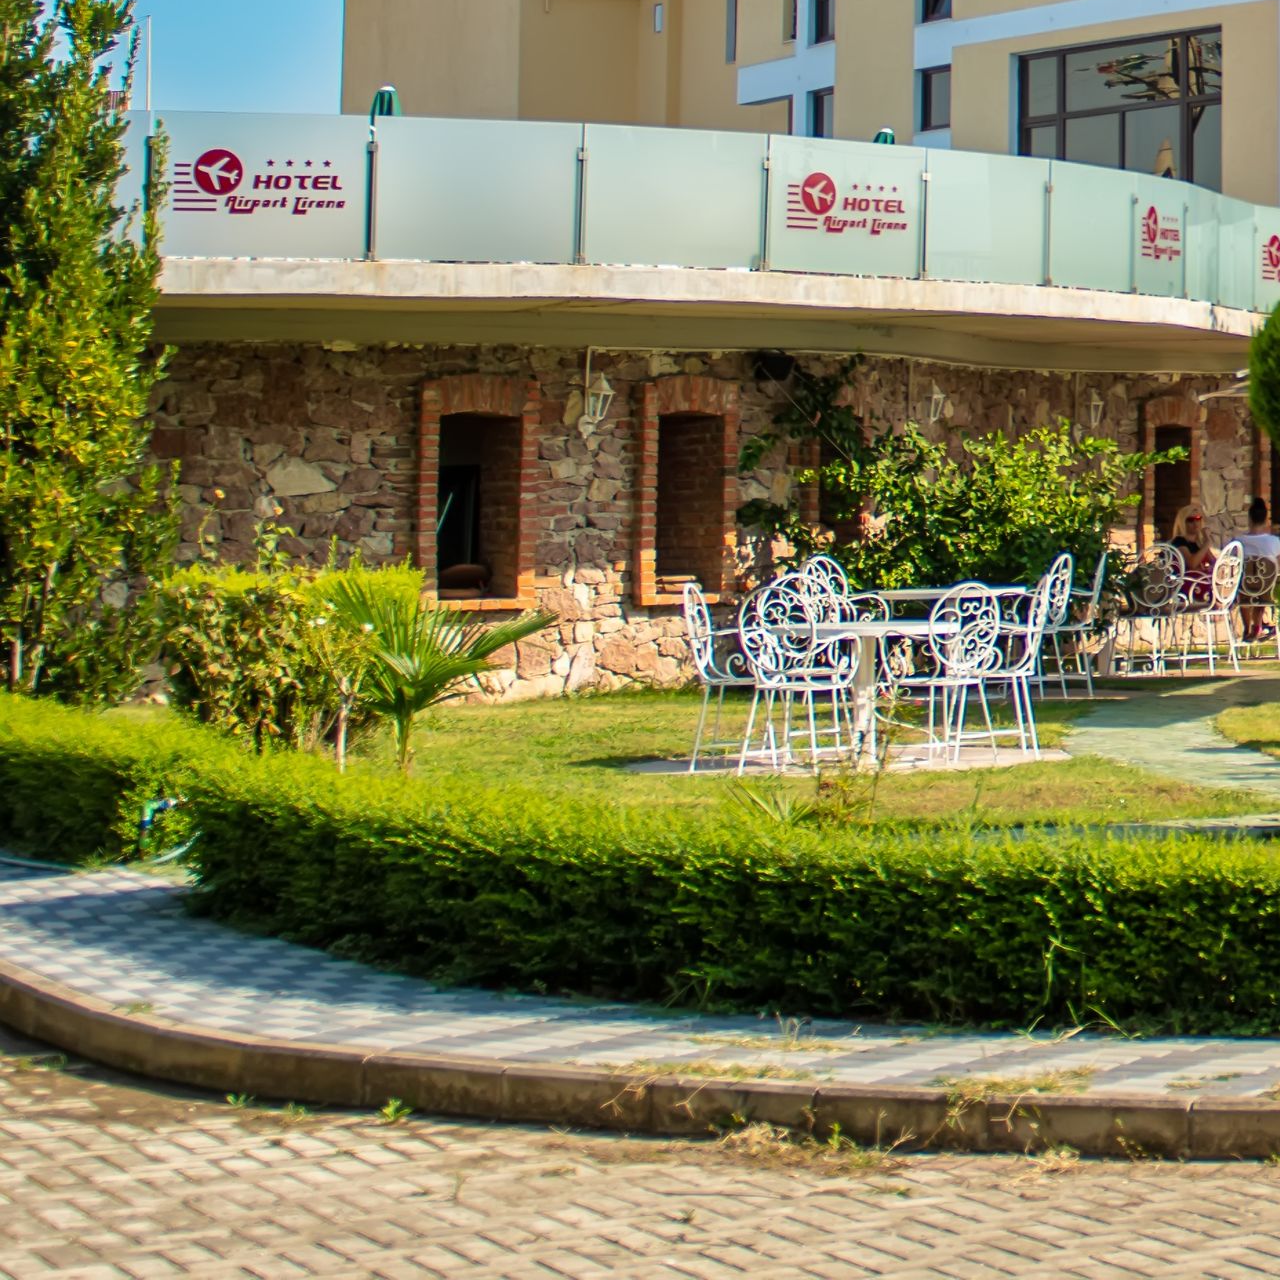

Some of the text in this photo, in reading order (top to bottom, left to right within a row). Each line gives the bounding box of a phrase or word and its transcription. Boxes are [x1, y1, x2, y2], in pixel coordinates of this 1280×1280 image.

[252, 175, 342, 190] HOTEL
[224, 196, 345, 215] Airport Tirana
[843, 197, 905, 213] HOTEL
